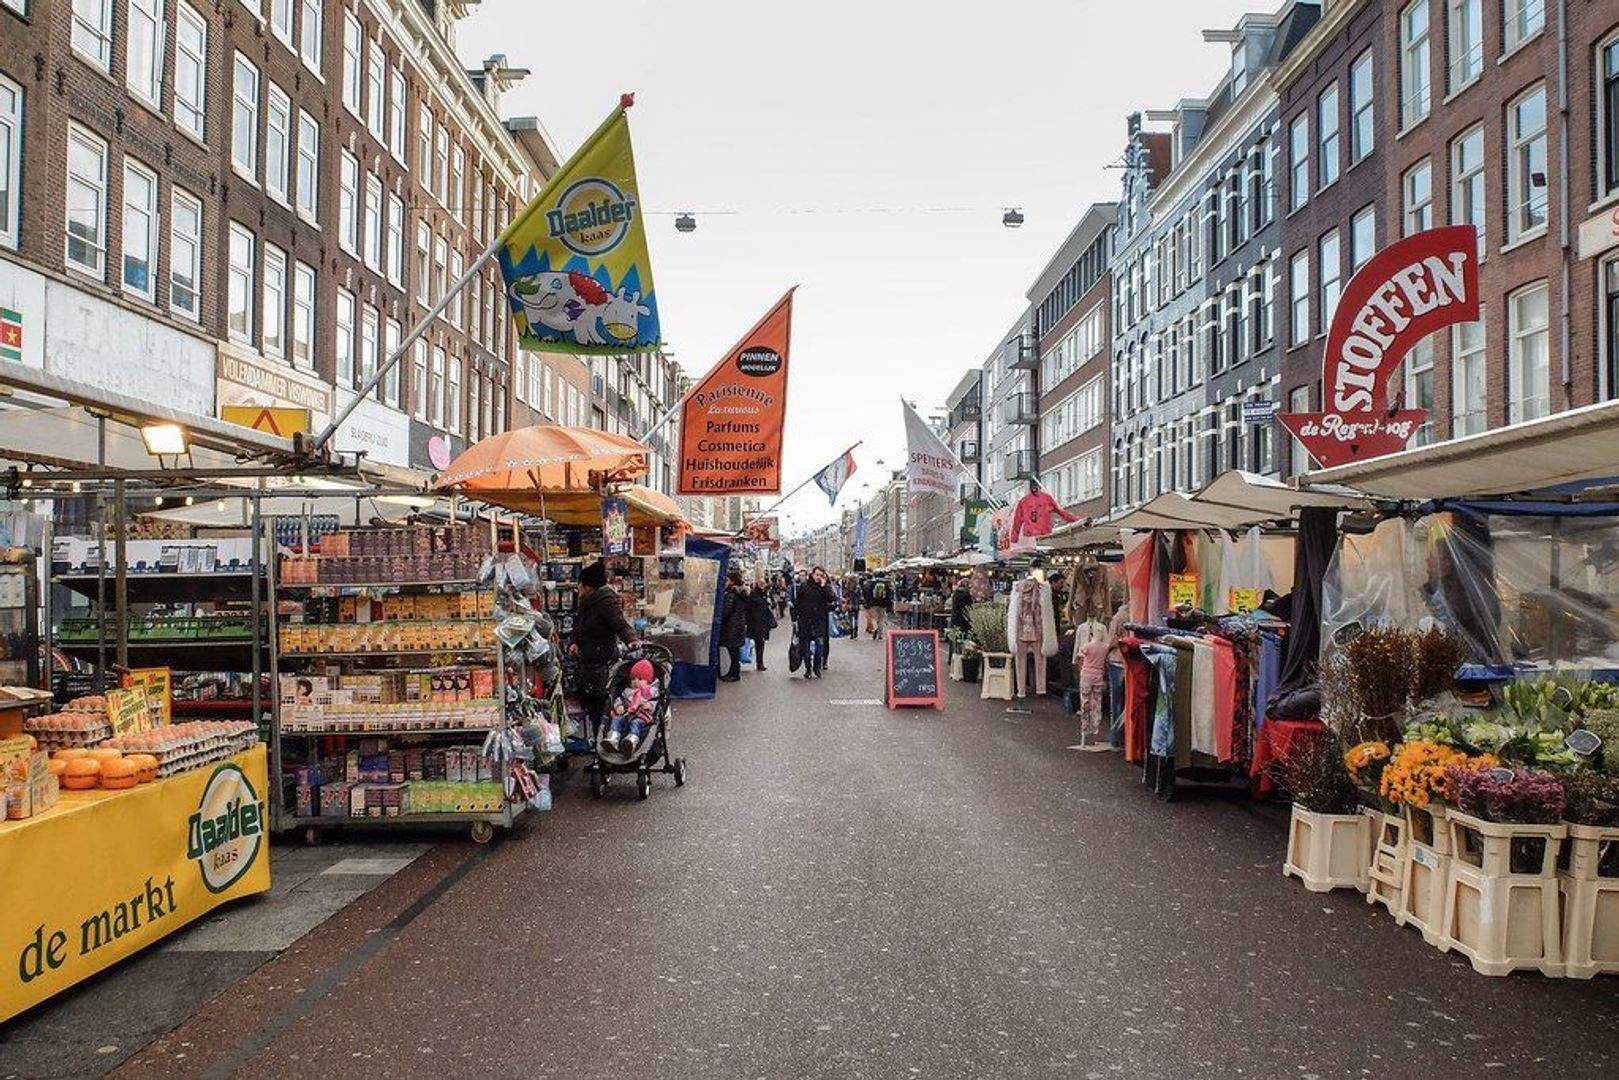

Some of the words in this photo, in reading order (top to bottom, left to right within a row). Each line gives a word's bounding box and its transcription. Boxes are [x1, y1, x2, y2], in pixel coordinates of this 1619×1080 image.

[546, 199, 636, 237] Daalder
[580, 229, 611, 243] kaas
[1334, 252, 1467, 412] STOFFEN
[740, 352, 779, 362] PINNEN
[223, 355, 287, 398] VOLENDAMMER
[696, 383, 773, 408] Parisienne
[707, 421, 760, 433] Parfums
[1300, 421, 1319, 436] de
[698, 439, 766, 452] Cosmetica
[686, 456, 774, 471] Huishoudelijk
[911, 452, 953, 470] SPETTERS
[692, 476, 767, 489] Frisdranken
[187, 797, 264, 859] Daalder
[213, 849, 239, 871] kaas
[18, 924, 67, 983] de
[79, 875, 178, 956] markt
